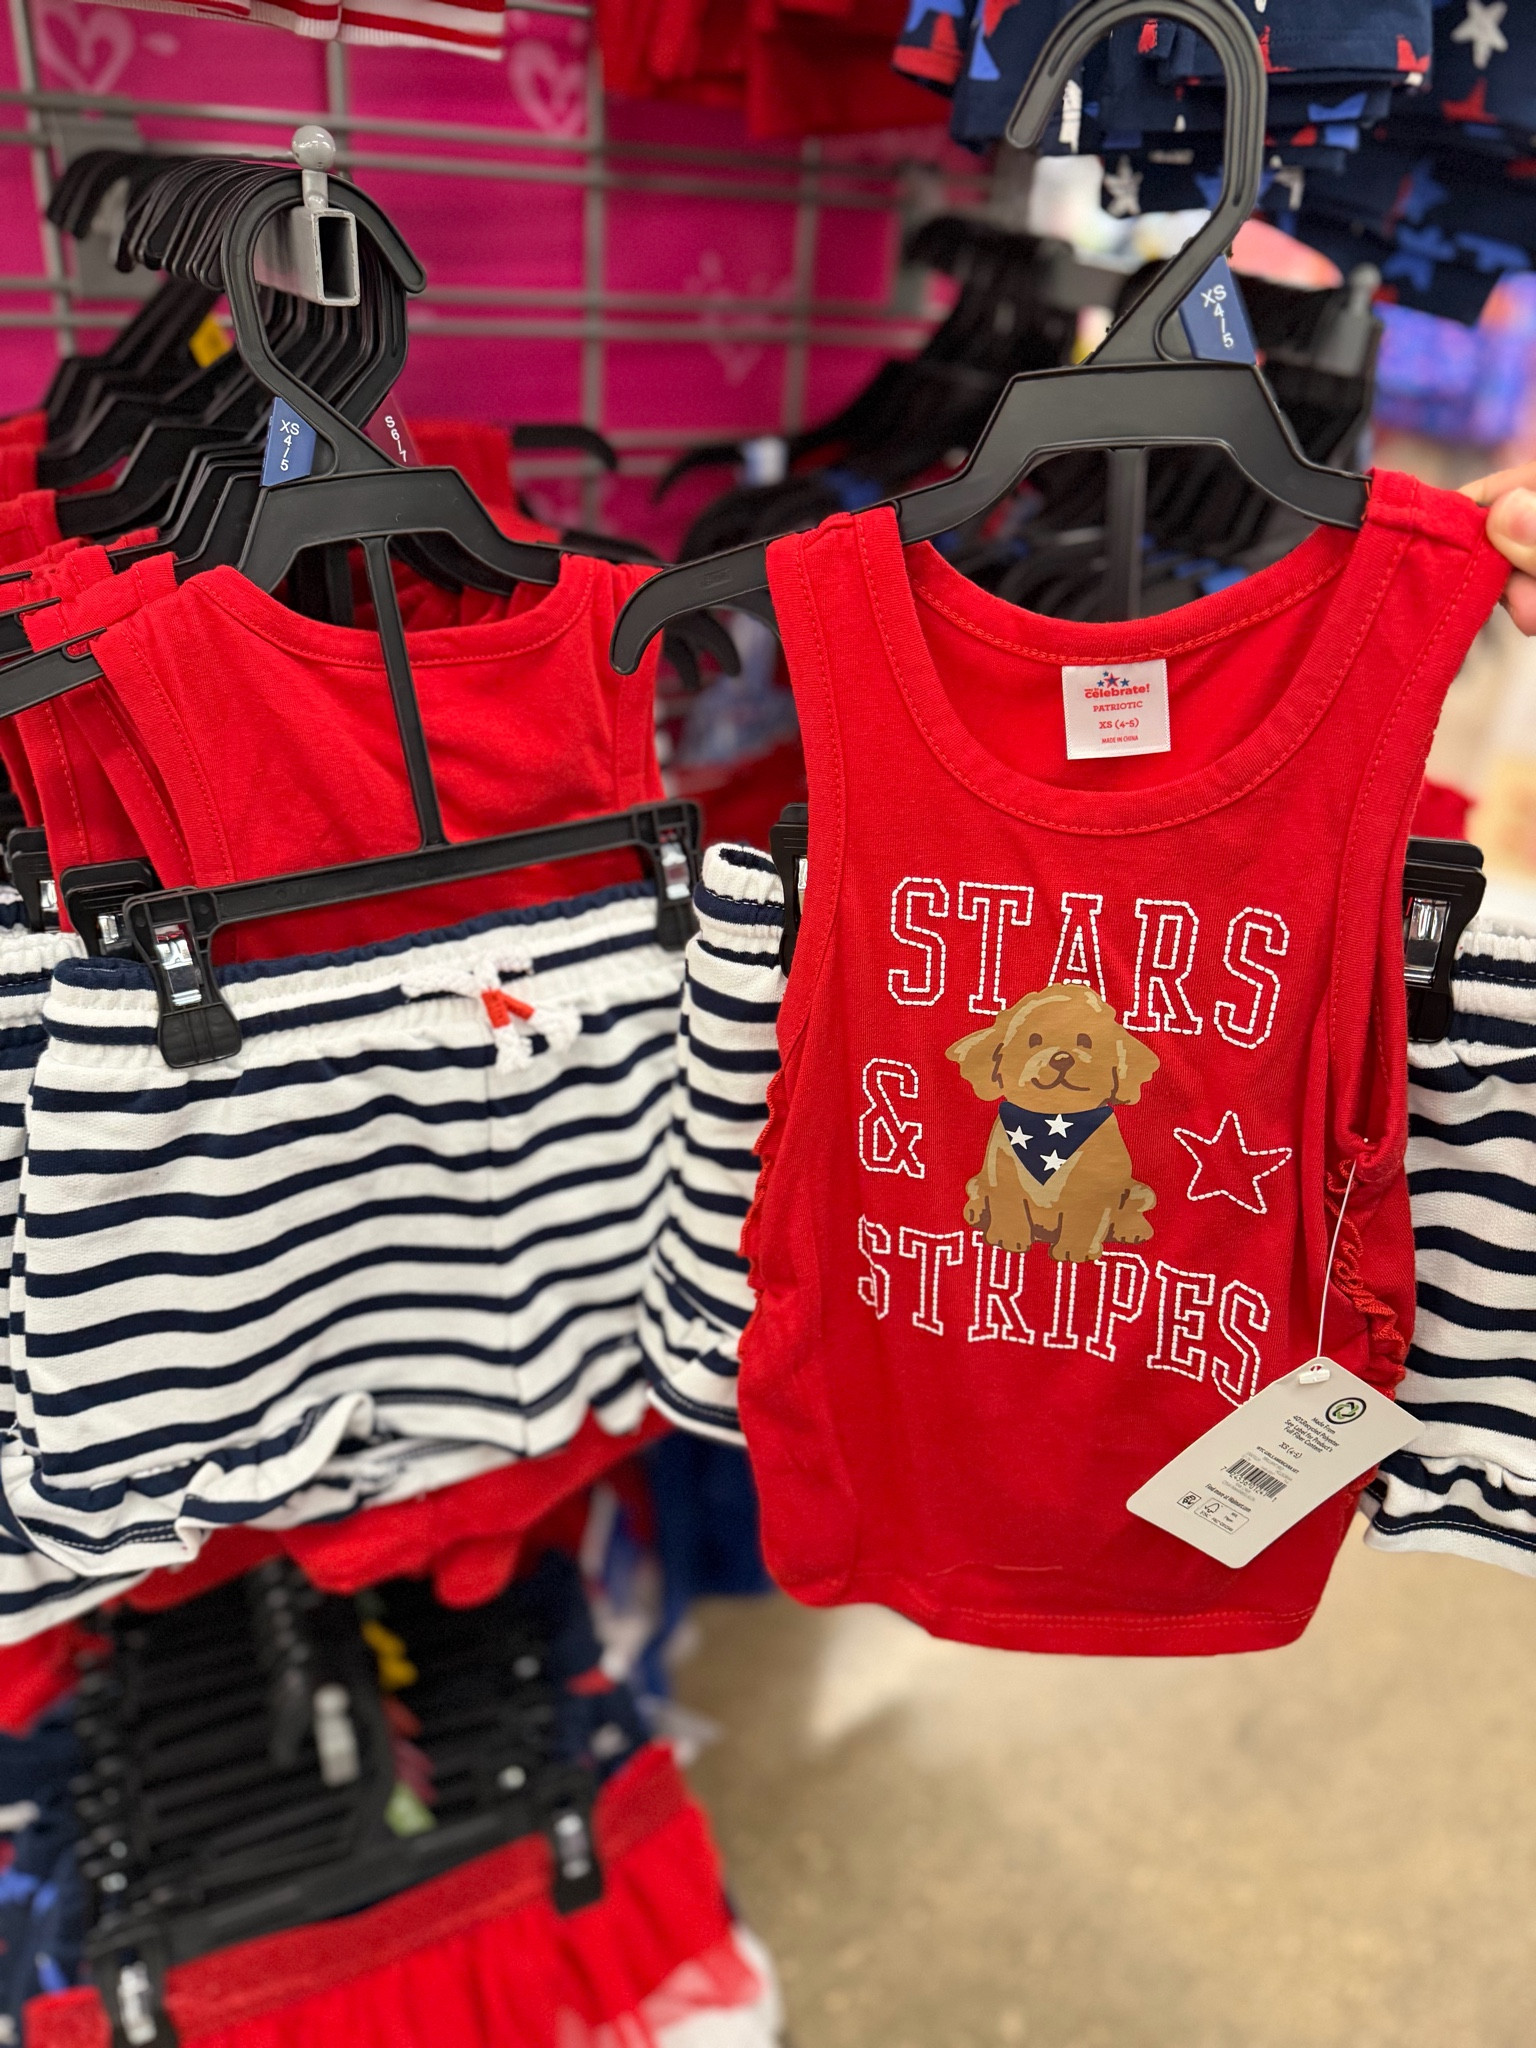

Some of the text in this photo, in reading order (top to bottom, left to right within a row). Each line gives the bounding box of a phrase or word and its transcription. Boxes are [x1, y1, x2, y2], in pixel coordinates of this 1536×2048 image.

[1200, 284, 1227, 308] XS
[280, 419, 300, 436] XS
[1084, 683, 1150, 699] celebrate!
[1093, 700, 1144, 712] PATRIOTIC
[1098, 717, 1140, 730] XS (4-5)
[887, 876, 1290, 1050] STARS
[858, 1057, 925, 1179] &
[857, 1213, 1271, 1408] STRIPES
[1284, 1419, 1294, 1427] See
[1293, 1425, 1307, 1435] Label
[1312, 1437, 1333, 1452] Product's
[1311, 1417, 1335, 1434] Made From
[1284, 1426, 1323, 1453] Full Fiber Content
[1320, 1433, 1339, 1447] Polyester
[1205, 1483, 1216, 1491] Find
[1228, 1497, 1251, 1512] Walmart.com
